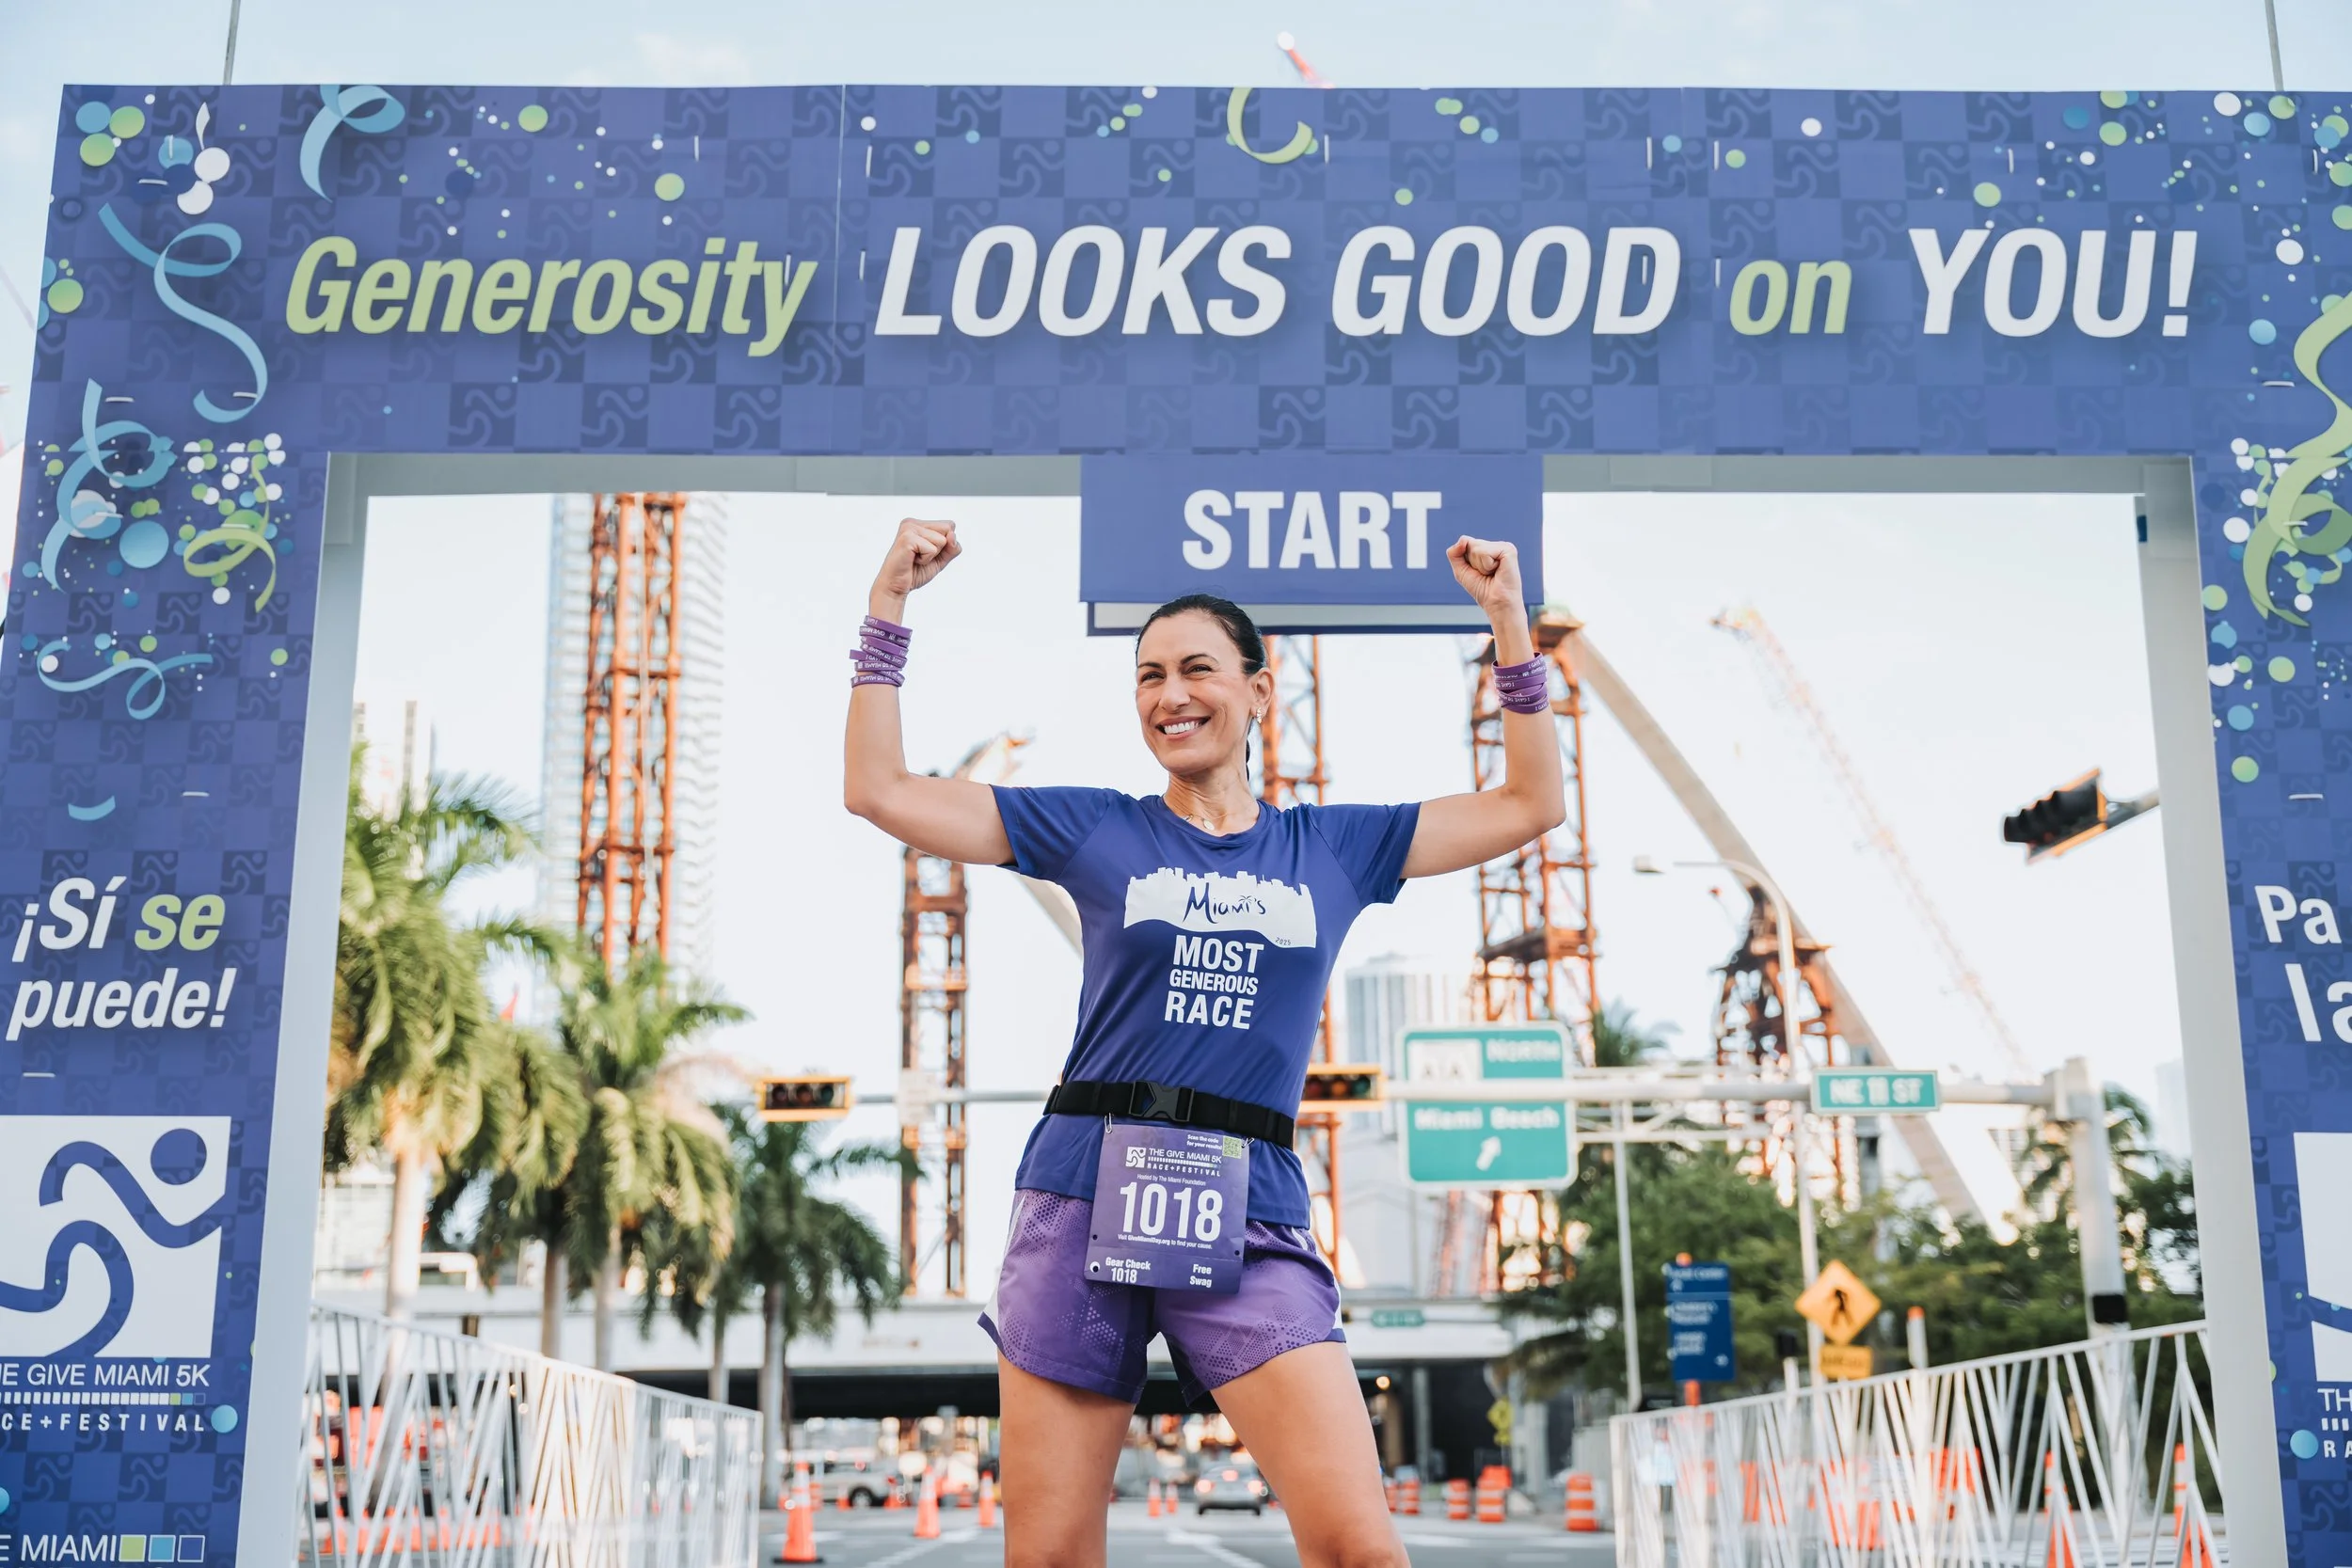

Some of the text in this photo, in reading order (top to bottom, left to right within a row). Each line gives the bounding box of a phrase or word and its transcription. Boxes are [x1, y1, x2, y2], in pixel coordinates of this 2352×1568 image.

[285, 225, 2199, 357] Generosity LOOKS GOOD on YOU!
[1182, 489, 1441, 571] START
[1183, 882, 1266, 925] Miami's
[2254, 885, 2343, 944] Pa
[11, 876, 226, 962] ¡Sí se
[1172, 934, 1264, 974] MOST
[1275, 937, 1292, 946] 2025
[1169, 968, 1259, 996] GENEROUS
[6, 968, 237, 1041] puede!
[1164, 990, 1254, 1030] RACE
[1830, 1078, 1865, 1104] NE
[1892, 1078, 1924, 1104] ST
[1414, 1106, 1560, 1131] Miami Beach
[1149, 1148, 1222, 1164] THE GIVE MIAMI 5K
[1182, 1178, 1206, 1186] Foundation
[1120, 1181, 1223, 1242] 1018
[1128, 1235, 1171, 1246] GiveMiamiDay.org
[1105, 1257, 1151, 1271] Gear Check
[1111, 1267, 1137, 1284] 1018
[1193, 1264, 1212, 1275] Free
[1190, 1275, 1212, 1288] Swag
[26, 1364, 86, 1386] GIVE
[95, 1365, 169, 1386] MIAMI
[176, 1365, 211, 1387] 5K
[21, 1534, 117, 1562] MIAMI
